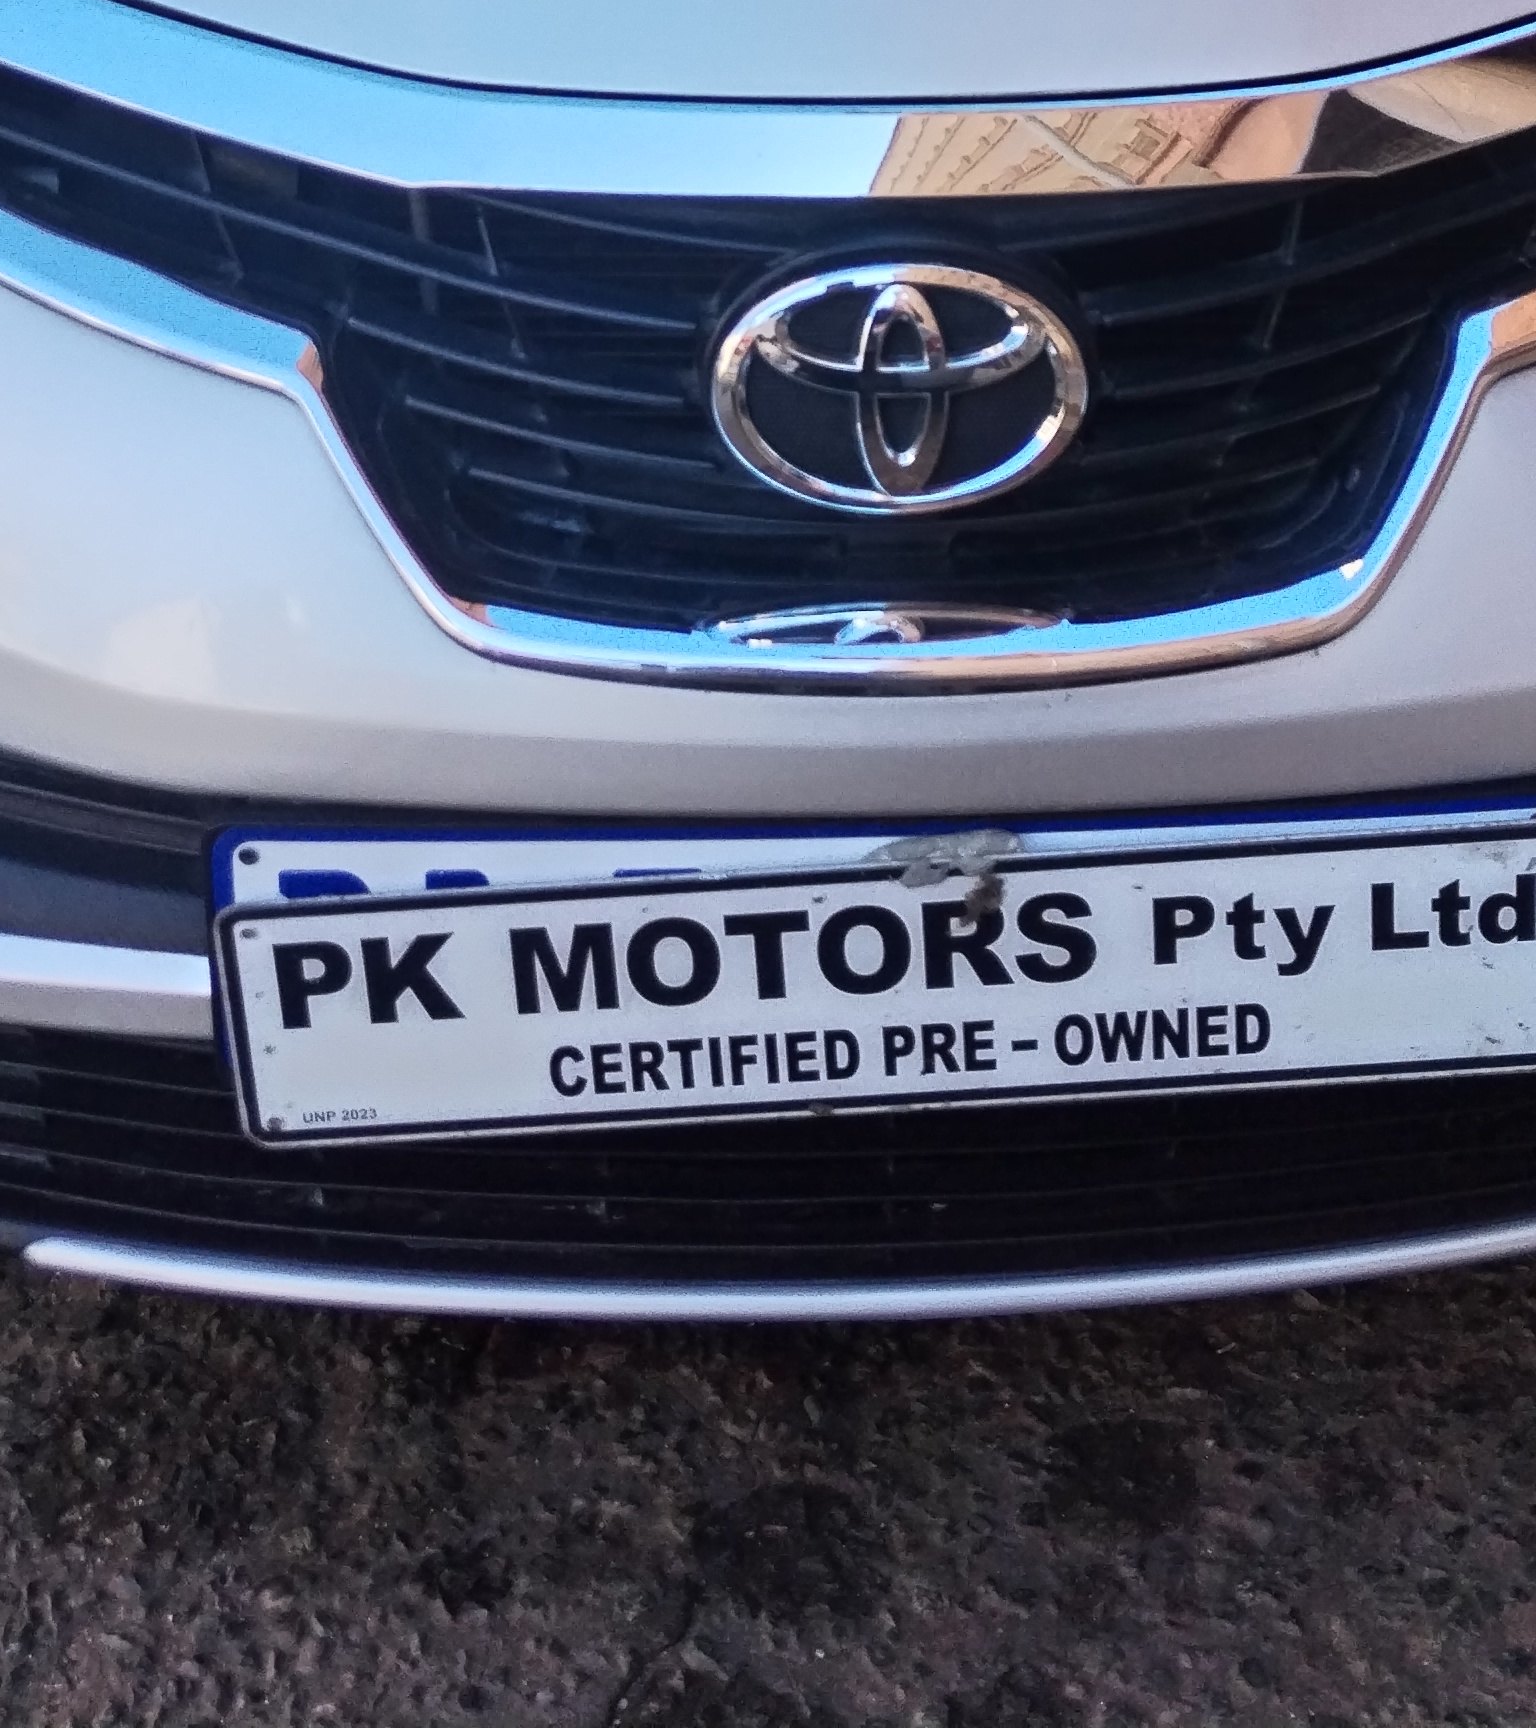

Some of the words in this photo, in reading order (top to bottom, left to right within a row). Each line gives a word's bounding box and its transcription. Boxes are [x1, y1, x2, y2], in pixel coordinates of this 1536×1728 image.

[271, 931, 467, 1030] PK
[509, 891, 1097, 1015] MOTORS
[1152, 891, 1335, 977] Pty
[549, 1028, 860, 1097] CERTIFIED
[302, 1110, 336, 1123] UNP
[341, 1107, 378, 1121] 2023
